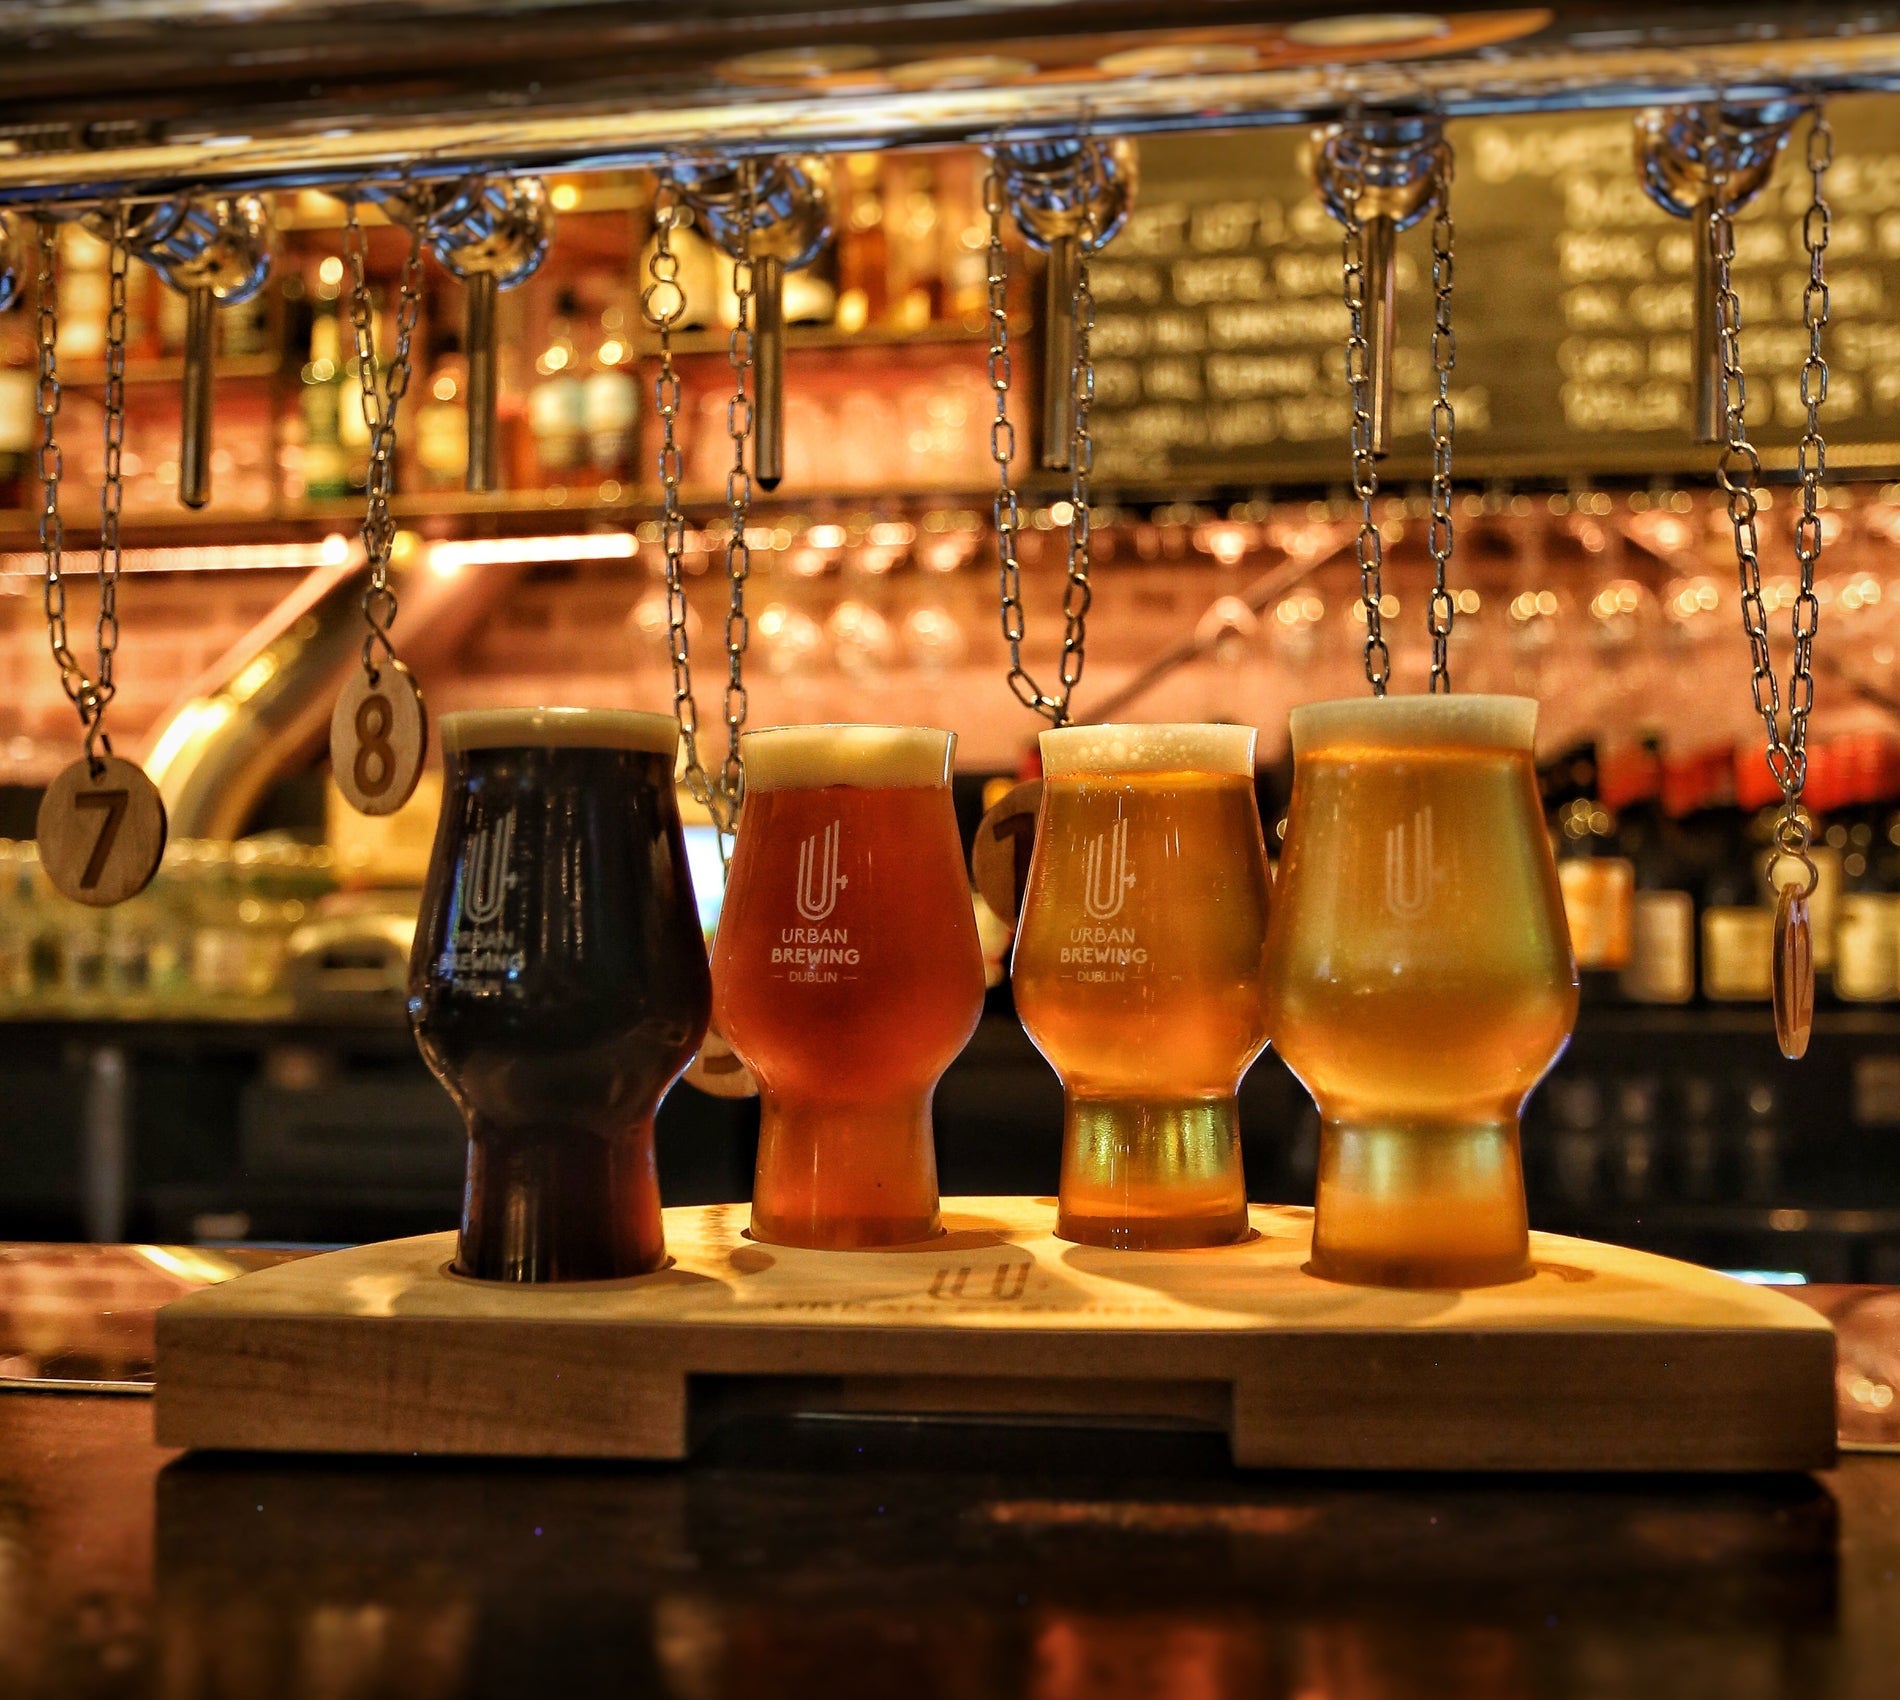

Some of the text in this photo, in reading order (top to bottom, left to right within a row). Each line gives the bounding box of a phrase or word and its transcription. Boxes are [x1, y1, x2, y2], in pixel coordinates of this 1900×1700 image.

[353, 694, 396, 797] 8
[75, 789, 129, 889] 7
[781, 928, 848, 944] URBAN
[1070, 927, 1136, 943] URBAN
[771, 947, 860, 965] BREWING
[1060, 946, 1148, 964] BREWING
[789, 971, 838, 983] DUBLIN
[1077, 970, 1125, 983] DUBLIN
